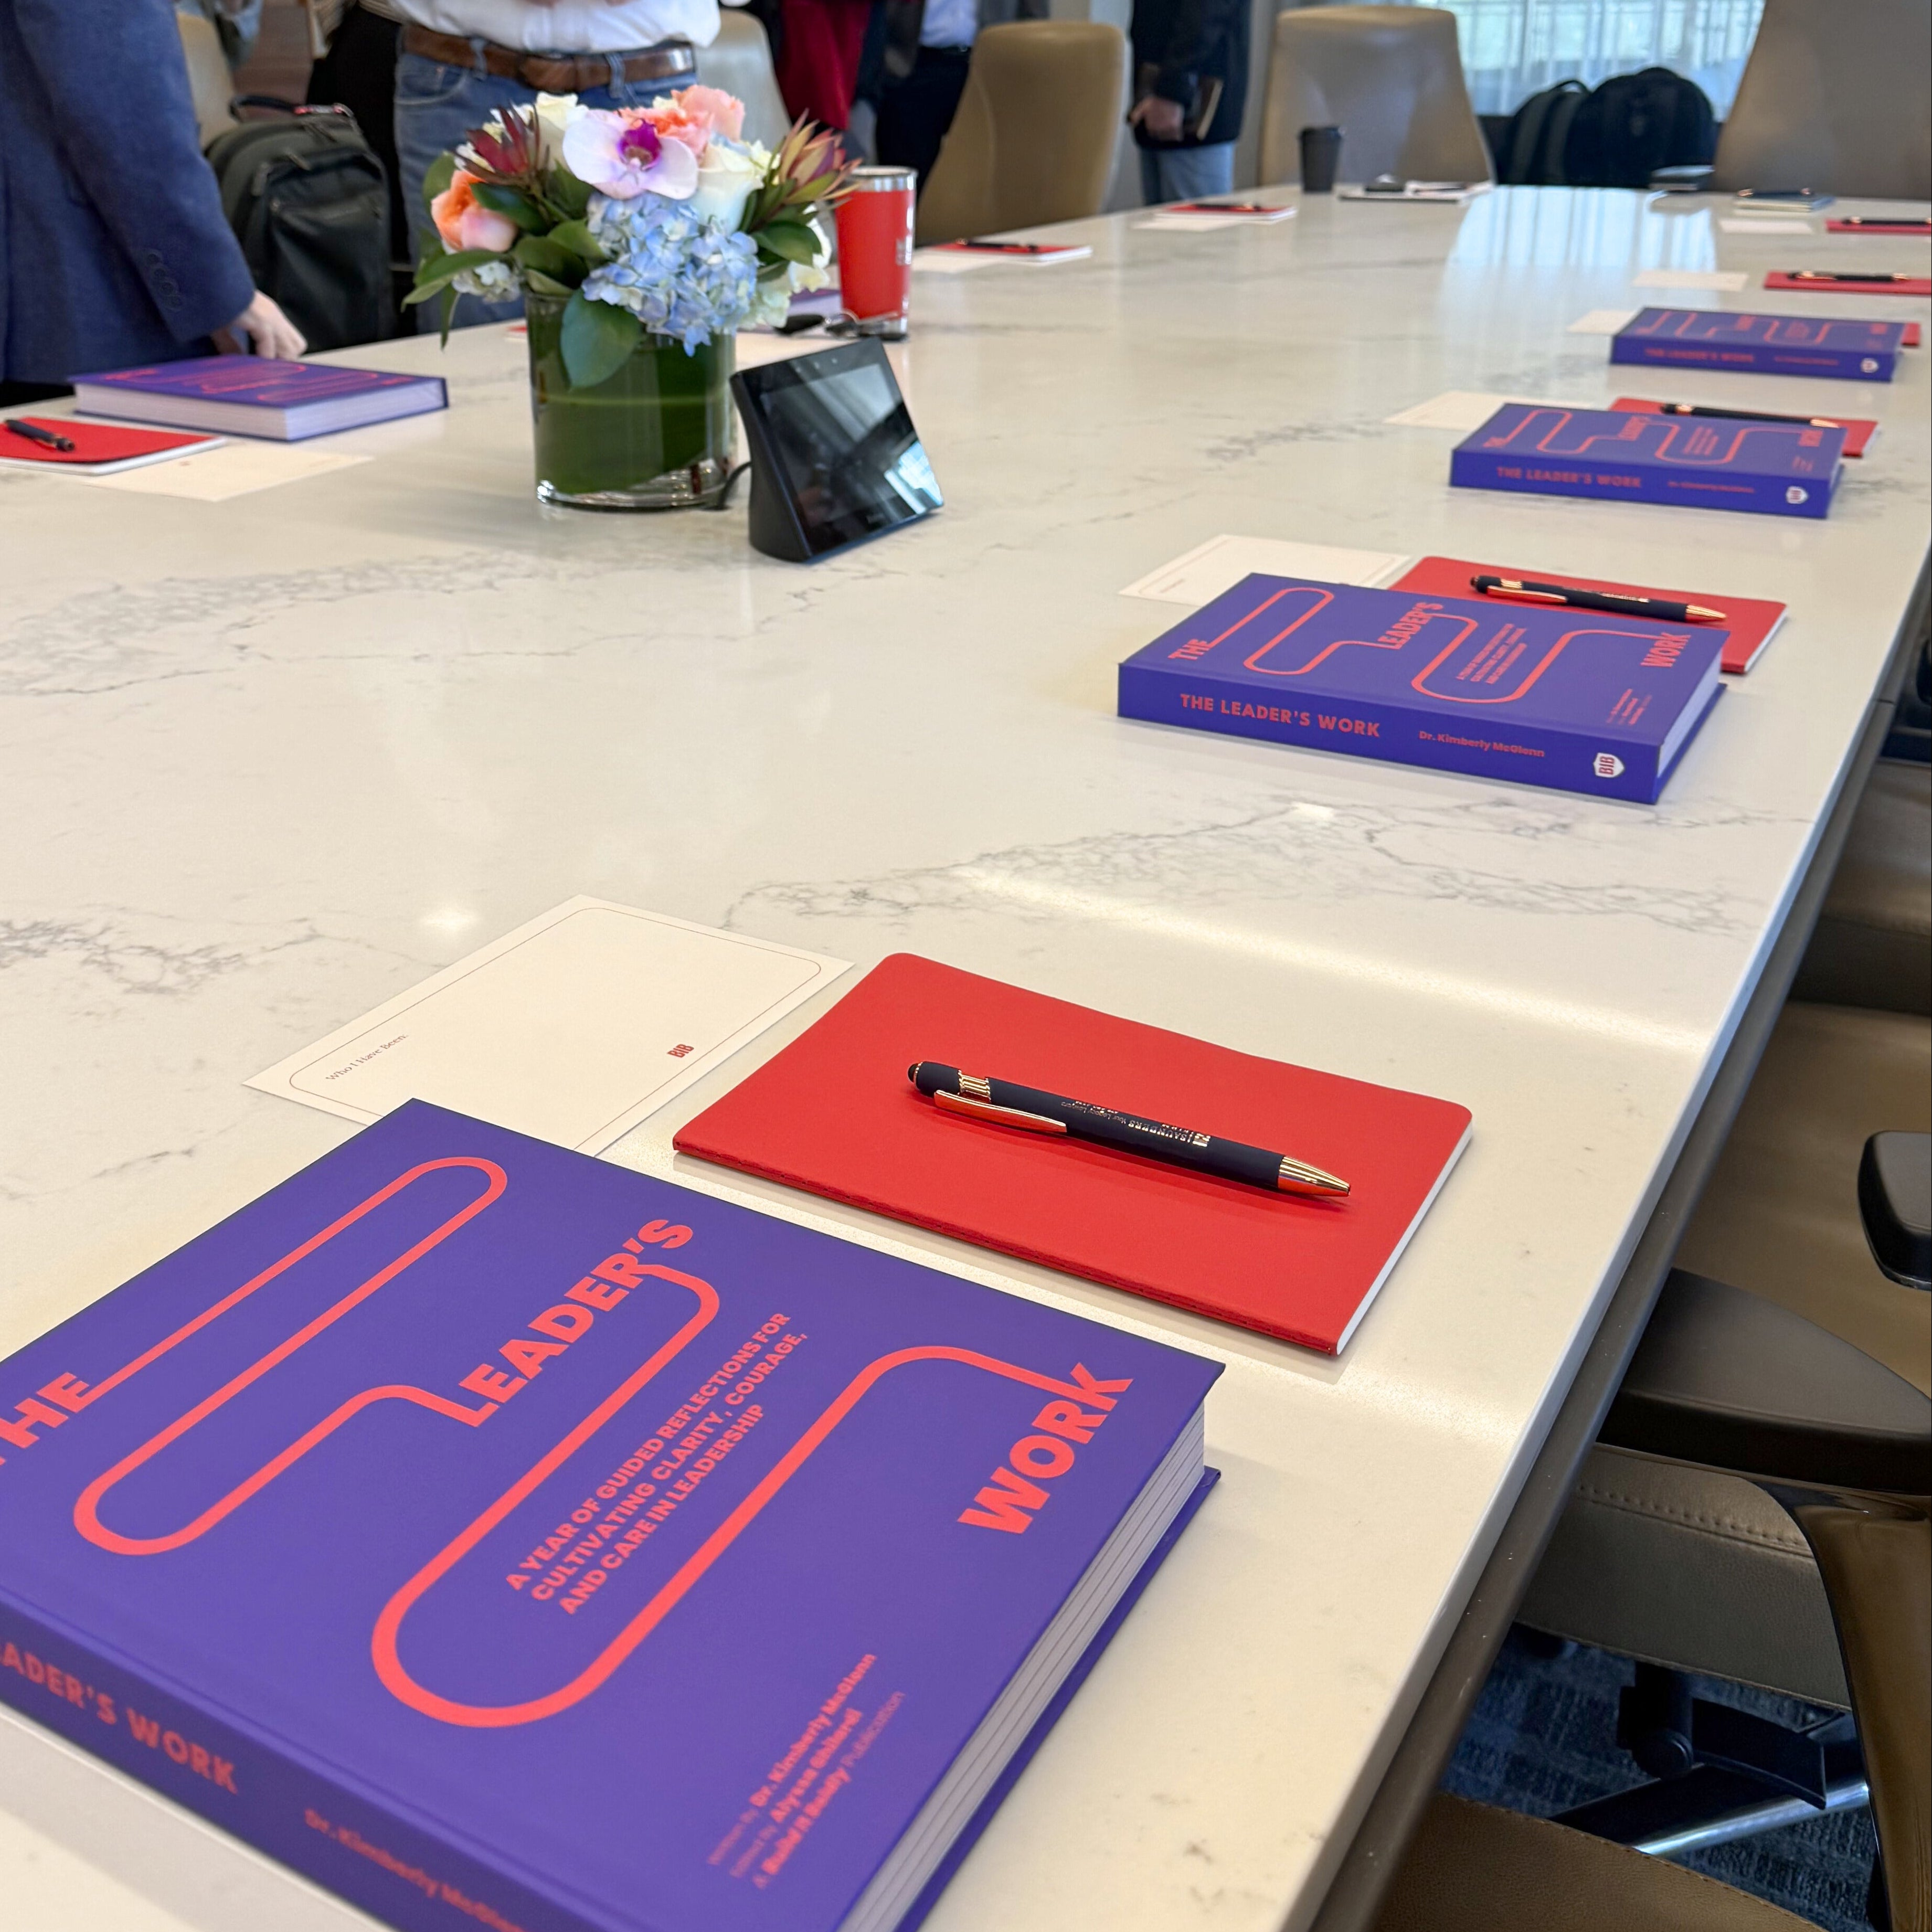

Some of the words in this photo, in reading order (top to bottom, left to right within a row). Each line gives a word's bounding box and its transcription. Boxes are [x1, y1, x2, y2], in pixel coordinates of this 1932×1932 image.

[1376, 601, 1445, 650] LEADER'S
[1167, 638, 1210, 660] THE
[1640, 631, 1691, 668] WORK
[1180, 693, 1213, 712] THE
[1220, 699, 1310, 727] LEADER'S
[1318, 714, 1380, 737] WORK
[1419, 730, 1436, 740] Dr.
[1437, 734, 1491, 752] Kimberly
[1599, 756, 1615, 776] BIB
[325, 1066, 353, 1080] Who
[355, 1049, 383, 1064] Have
[666, 1044, 694, 1058] BIB
[1128, 1119, 1187, 1142] SAUNDERS
[431, 1219, 694, 1427] LEADER'S
[0, 1372, 91, 1468] HE
[506, 1573, 530, 1590] A
[519, 1524, 579, 1571] YEAR
[570, 1497, 600, 1525] OF
[596, 1438, 664, 1500] GUIDED
[656, 1341, 761, 1439] REFLECTIONS
[752, 1312, 790, 1344] FOR
[531, 1483, 656, 1601] CULTIVATING
[725, 1333, 808, 1406] COURAGE,
[957, 1362, 1134, 1534] WORK
[559, 1569, 607, 1615] AND
[600, 1519, 657, 1570] CARE
[647, 1494, 677, 1523] IN
[676, 1404, 764, 1502] LEADERSHIP
[0, 1641, 116, 1725] ADER'S
[126, 1707, 238, 1795] WORK
